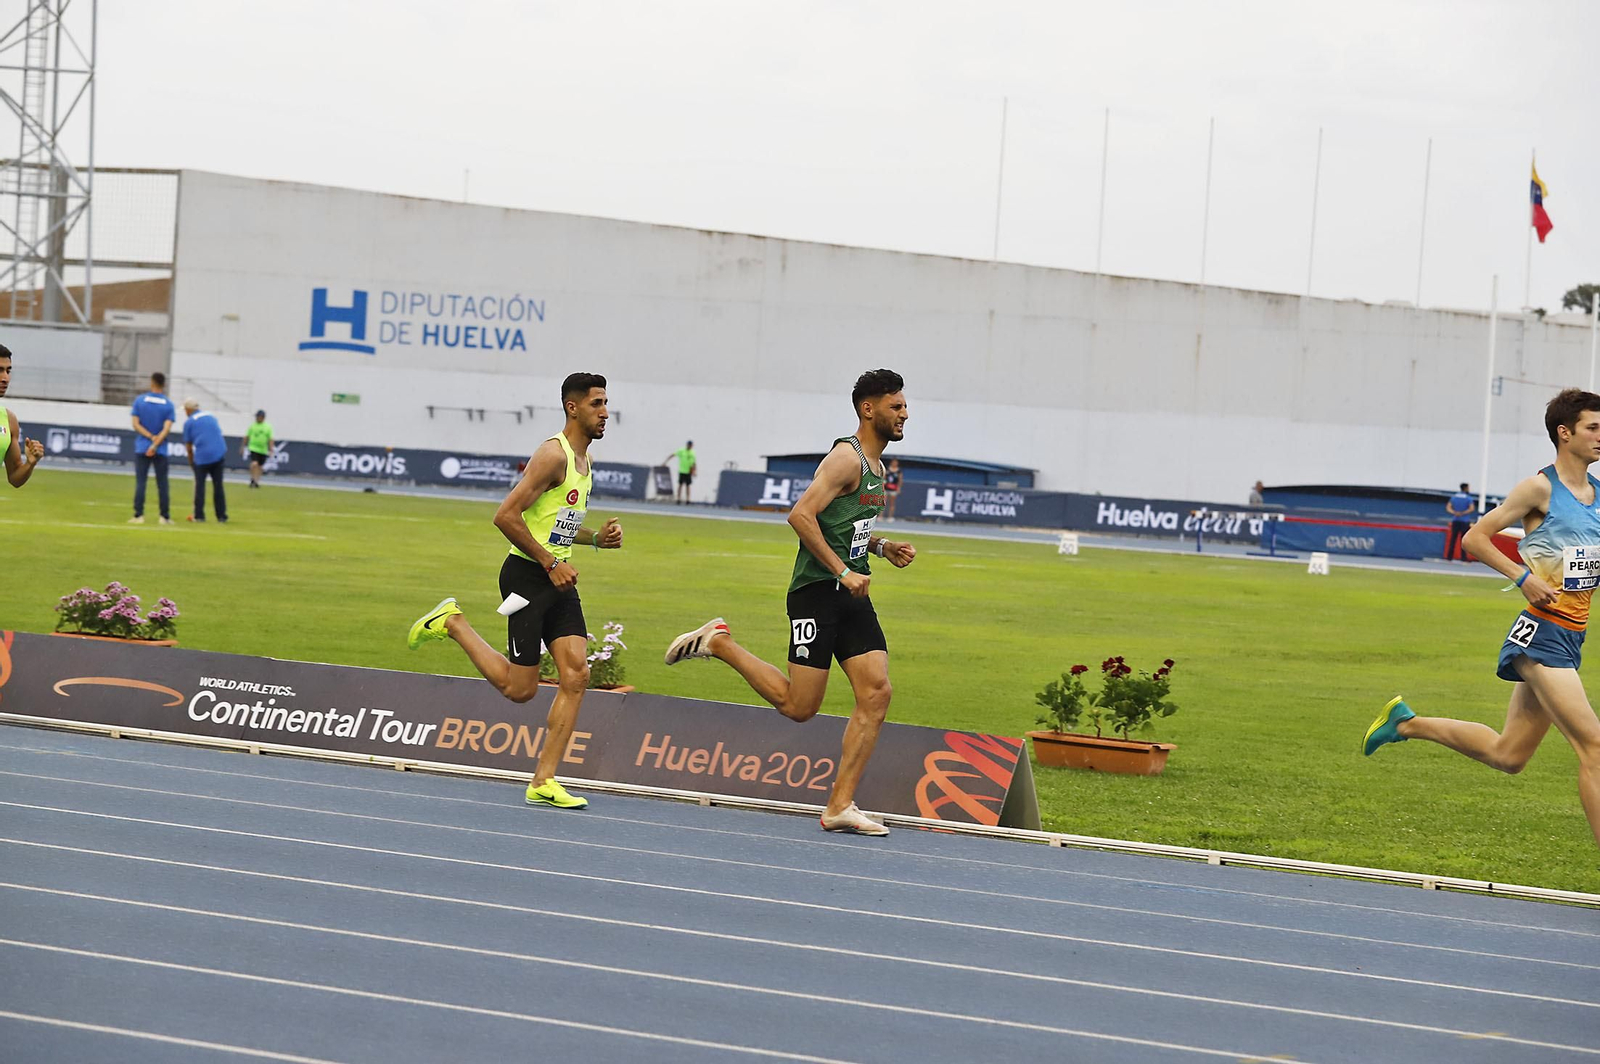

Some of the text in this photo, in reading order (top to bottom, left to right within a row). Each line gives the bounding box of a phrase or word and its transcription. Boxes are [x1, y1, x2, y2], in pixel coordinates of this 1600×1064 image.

[380, 290, 546, 322] DIPUTACIÓN
[379, 321, 528, 352] DE HUELVA
[324, 452, 407, 476] enovis
[954, 502, 1017, 517] DE HUELVA
[955, 490, 1025, 506] DIPUTACIÓN
[1096, 502, 1179, 530] Huelva
[794, 621, 816, 641] 10
[1510, 619, 1536, 645] 22
[199, 676, 237, 690] WORLD
[187, 690, 593, 765] Continental Tour BRONE
